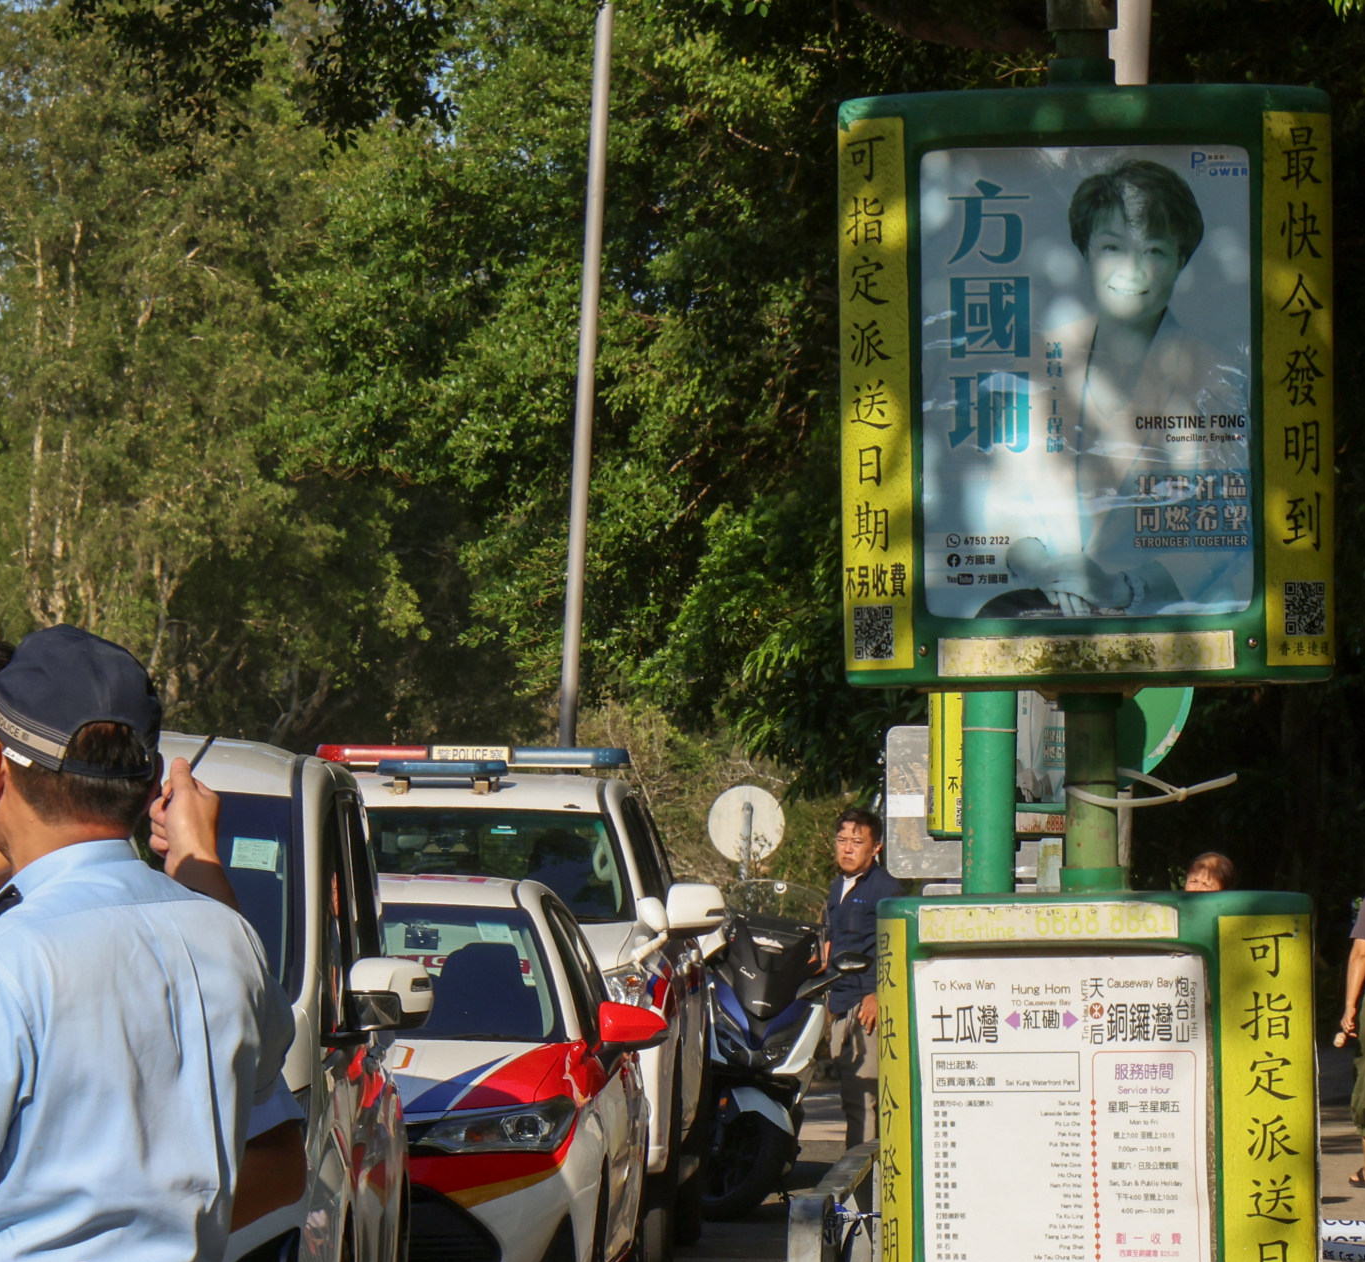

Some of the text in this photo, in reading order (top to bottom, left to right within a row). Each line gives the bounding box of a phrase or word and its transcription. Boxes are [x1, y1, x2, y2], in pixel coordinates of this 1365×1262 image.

[947, 179, 1032, 453] 方國珊
[846, 135, 893, 553] 可指定派送日期
[1279, 126, 1324, 553] 最快今發明到
[1136, 415, 1245, 429] CHRISTINE FONG
[1166, 434, 1208, 443] Councillor,
[1136, 506, 1247, 532] 同燃希望
[964, 536, 1010, 545] 6750 2122
[1135, 536, 1247, 547] STRONGER TOGETHER
[845, 562, 906, 599] 不另收費
[1036, 908, 1100, 936] 6888
[1110, 906, 1172, 934] 8861
[932, 980, 995, 991] To Kwa Wan
[1011, 984, 1071, 996] Hung Hom
[1107, 978, 1174, 990] Causeway Bay
[1023, 1009, 1059, 1030] 紅磡
[1175, 976, 1190, 1043] 炮台山
[1189, 981, 1198, 1039] Fortress Hill
[931, 1004, 999, 1044] 土瓜灣
[1106, 1003, 1174, 1042] 銅鑼灣
[1114, 1063, 1173, 1080] 服務時間
[1117, 1086, 1170, 1095] Service Hour
[1108, 1101, 1180, 1113] 星期一至星期五
